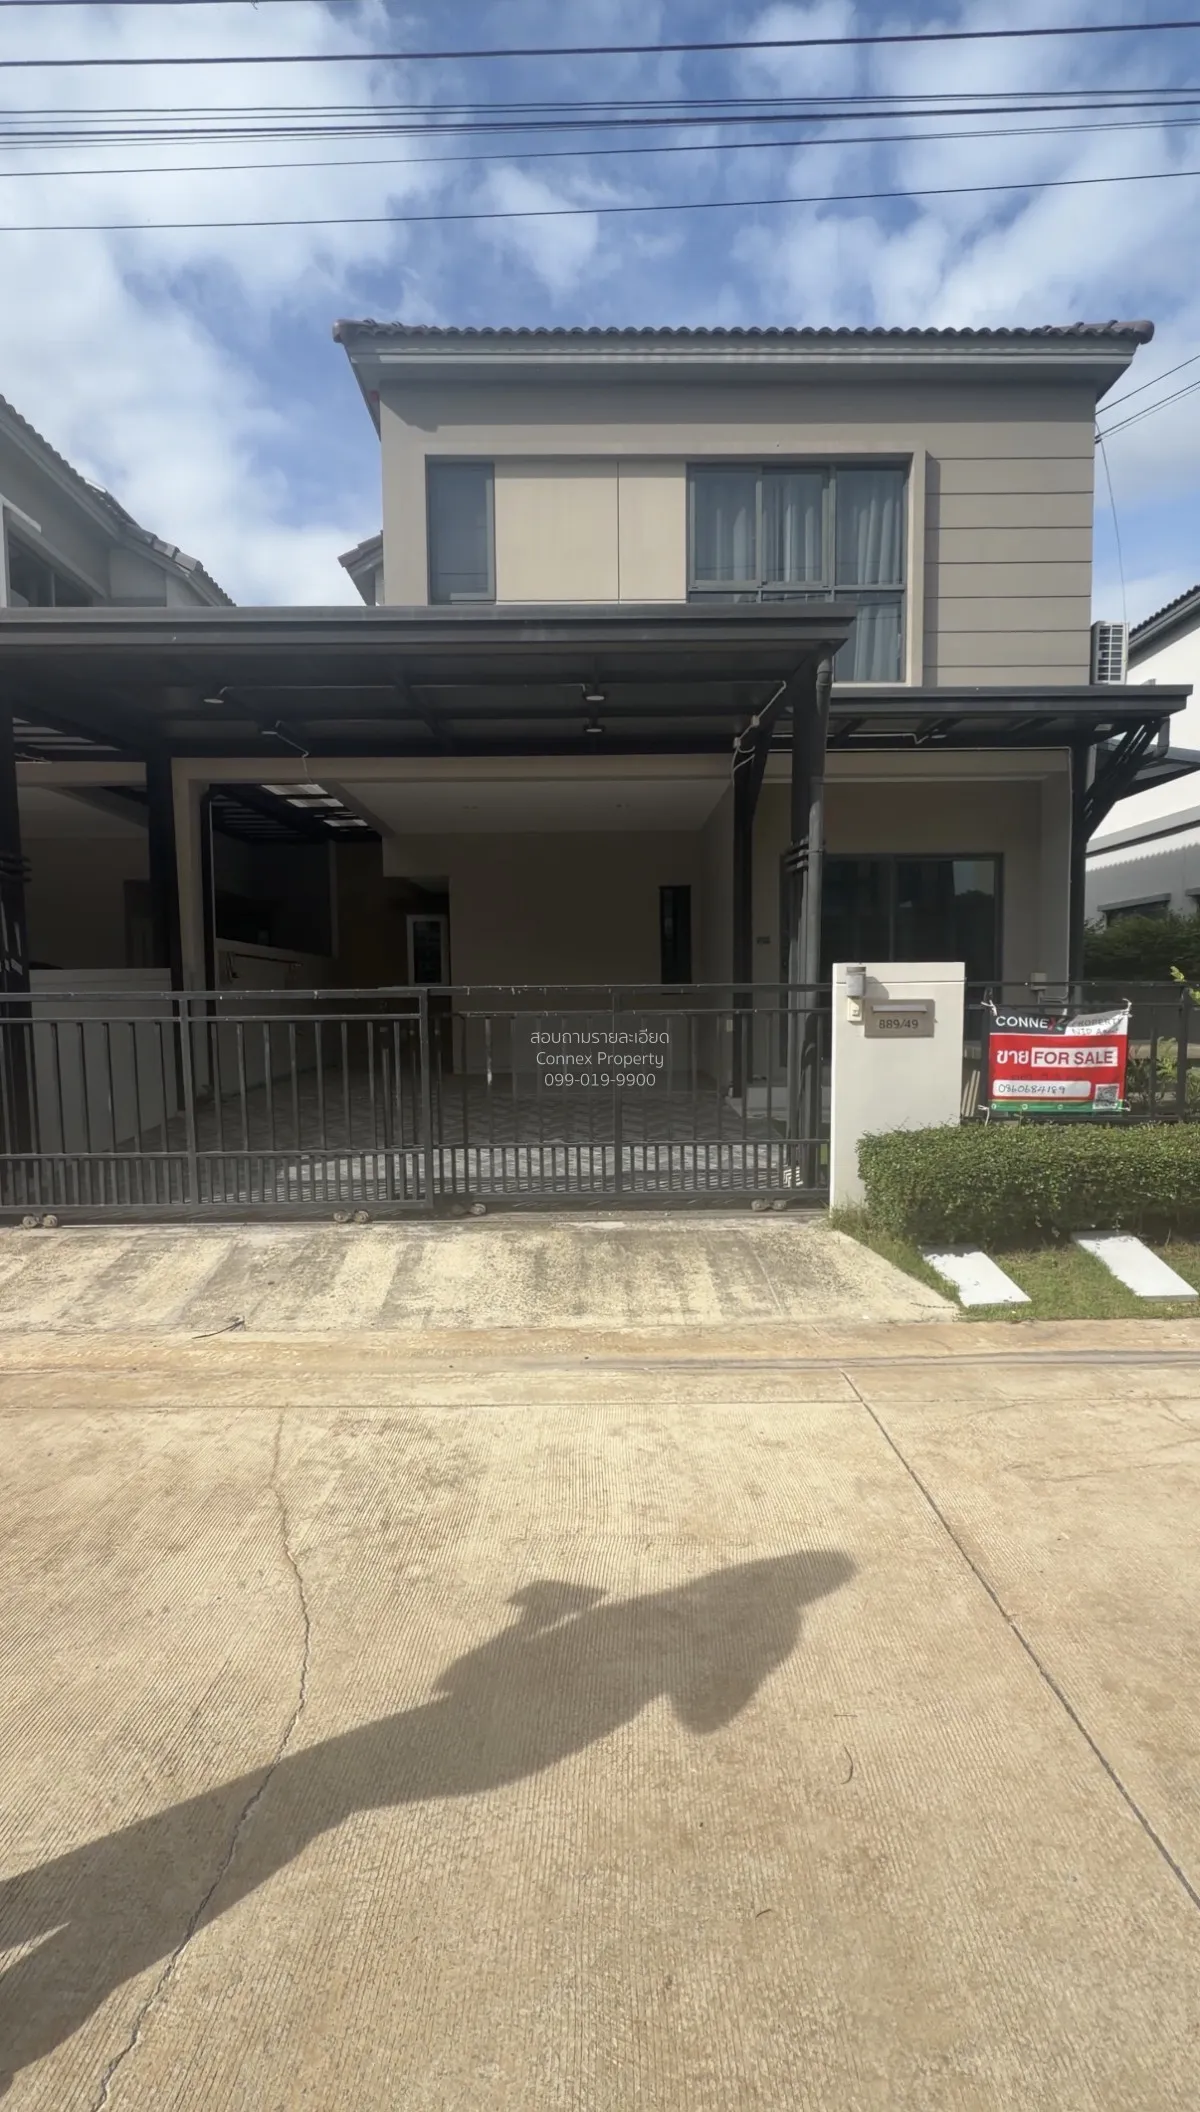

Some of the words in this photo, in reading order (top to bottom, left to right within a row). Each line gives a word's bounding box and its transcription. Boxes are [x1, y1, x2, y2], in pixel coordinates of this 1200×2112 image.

[878, 1019, 919, 1030] 889/49
[996, 1049, 1029, 1065] ขาย
[1033, 1051, 1069, 1065] FOR
[1073, 1050, 1114, 1065] SALE
